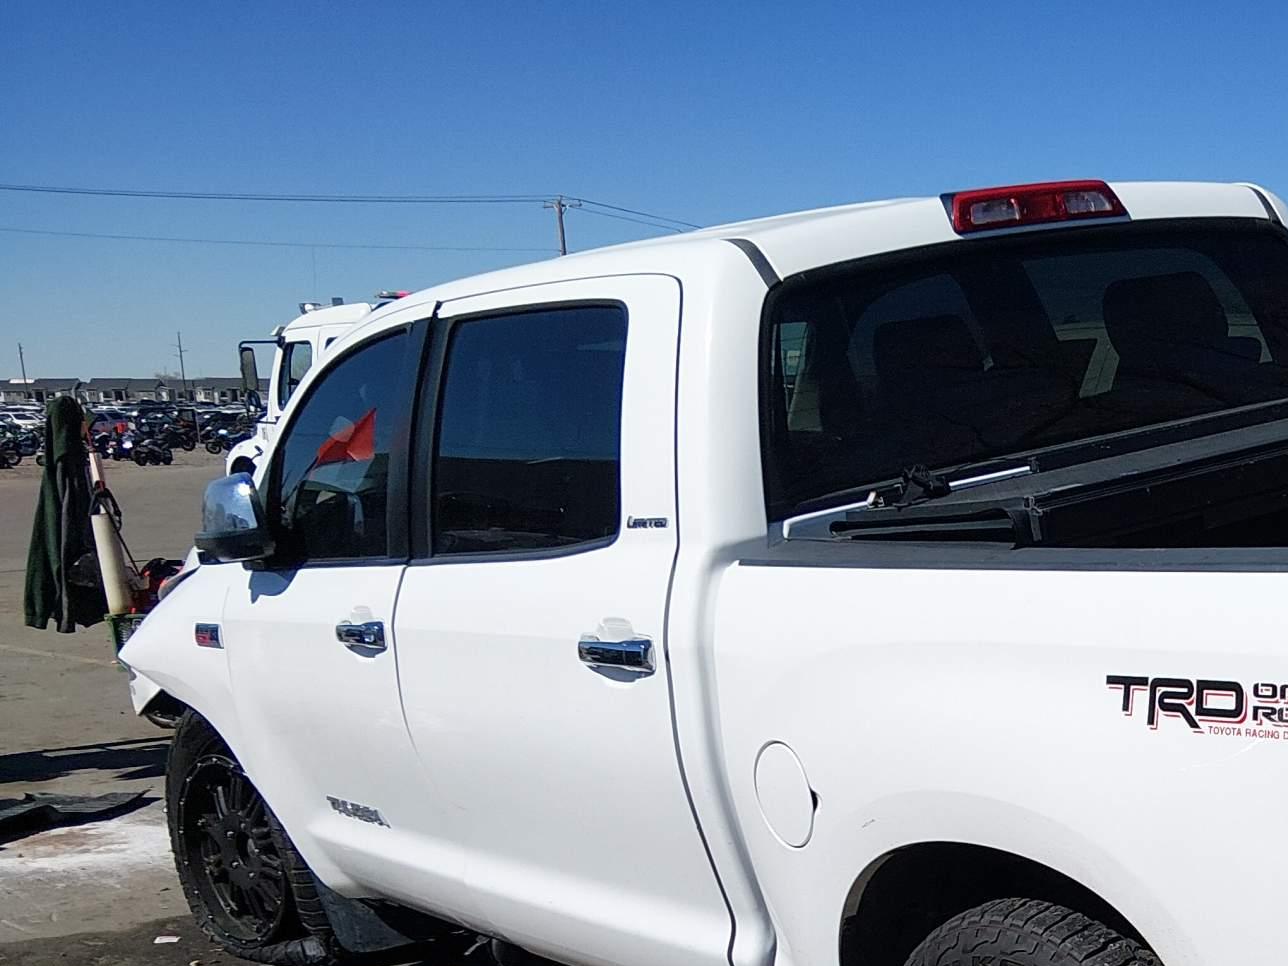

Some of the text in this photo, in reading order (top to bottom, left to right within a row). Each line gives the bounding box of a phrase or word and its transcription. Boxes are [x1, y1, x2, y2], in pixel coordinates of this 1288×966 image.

[1106, 675, 1247, 733] TRD
[1208, 725, 1242, 737] TOYOTA
[1245, 728, 1280, 740] RACING
